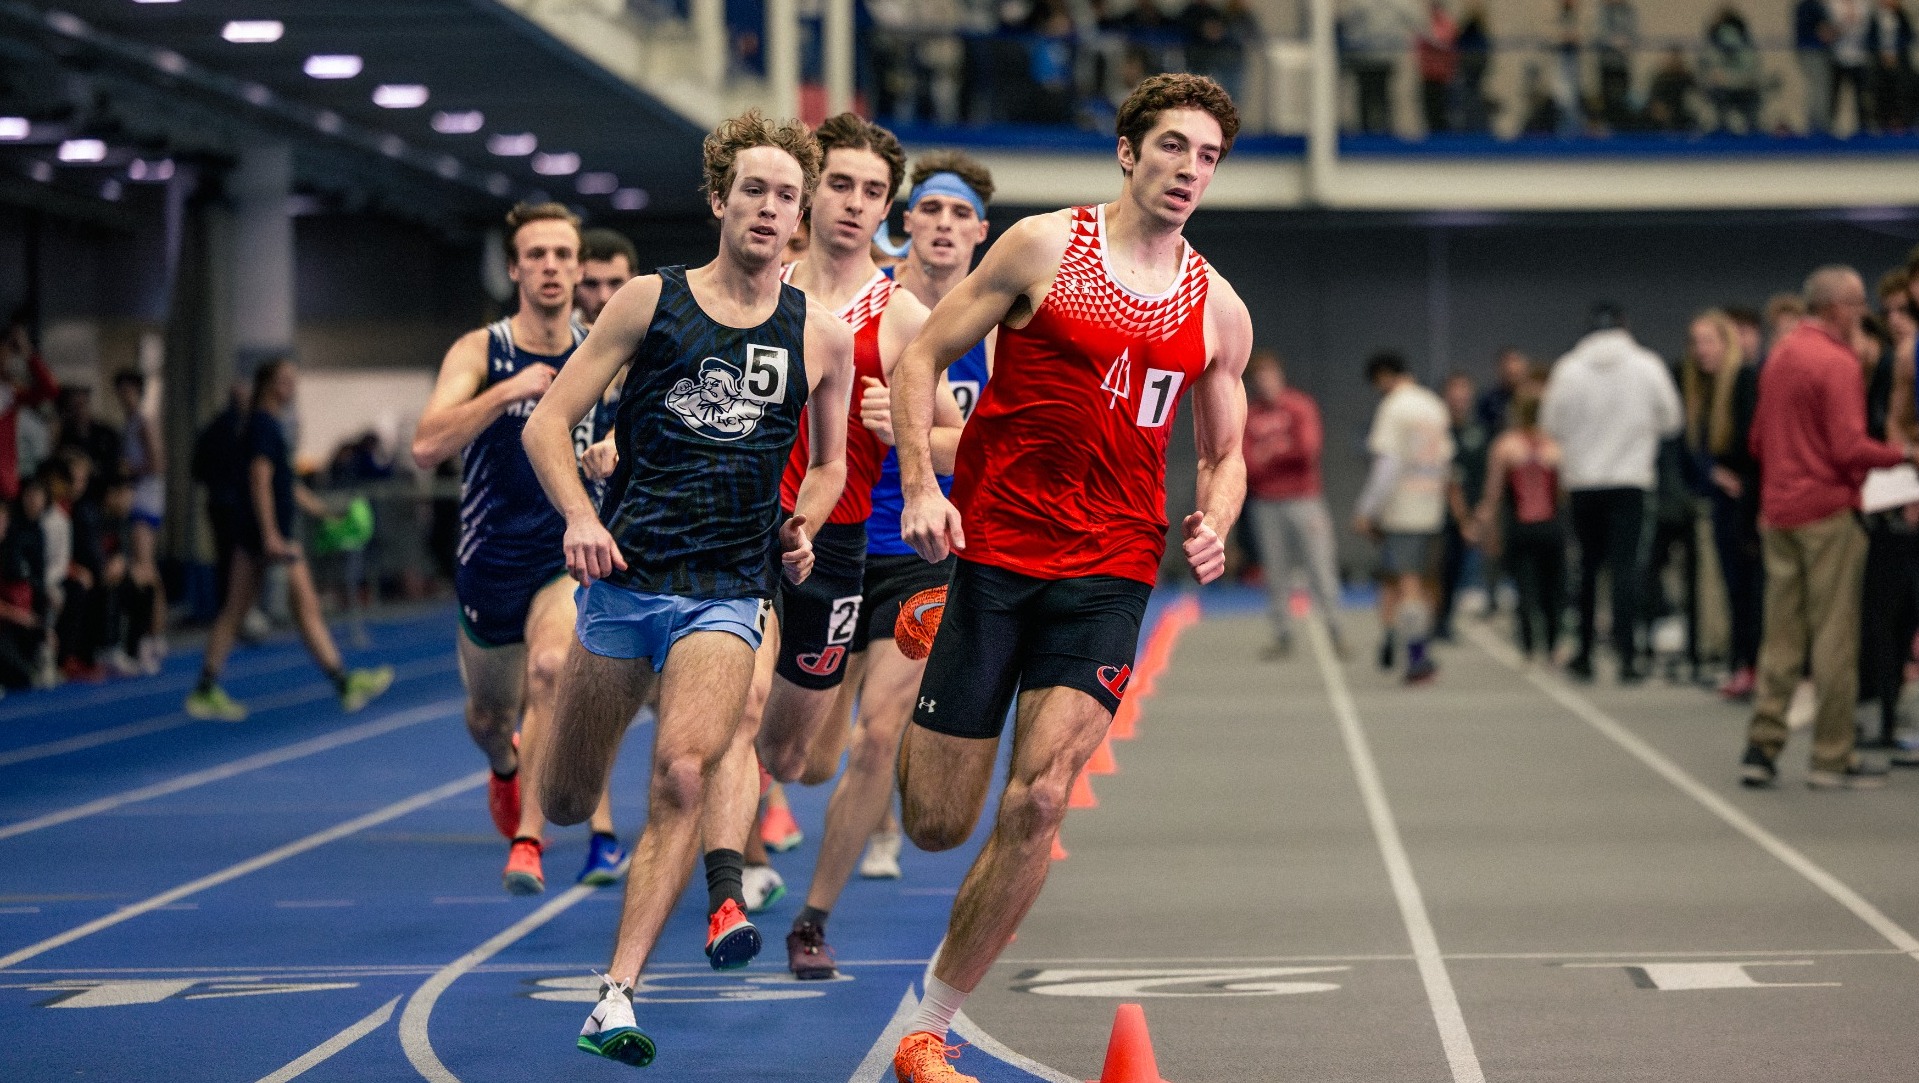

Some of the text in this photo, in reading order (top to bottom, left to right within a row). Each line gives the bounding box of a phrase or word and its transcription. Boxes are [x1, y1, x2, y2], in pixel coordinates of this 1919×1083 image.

[748, 347, 779, 397] 5
[952, 386, 973, 421] 9
[1151, 374, 1173, 424] 1
[570, 425, 588, 462] 6
[832, 601, 856, 642] 2
[1027, 965, 1349, 997] 2
